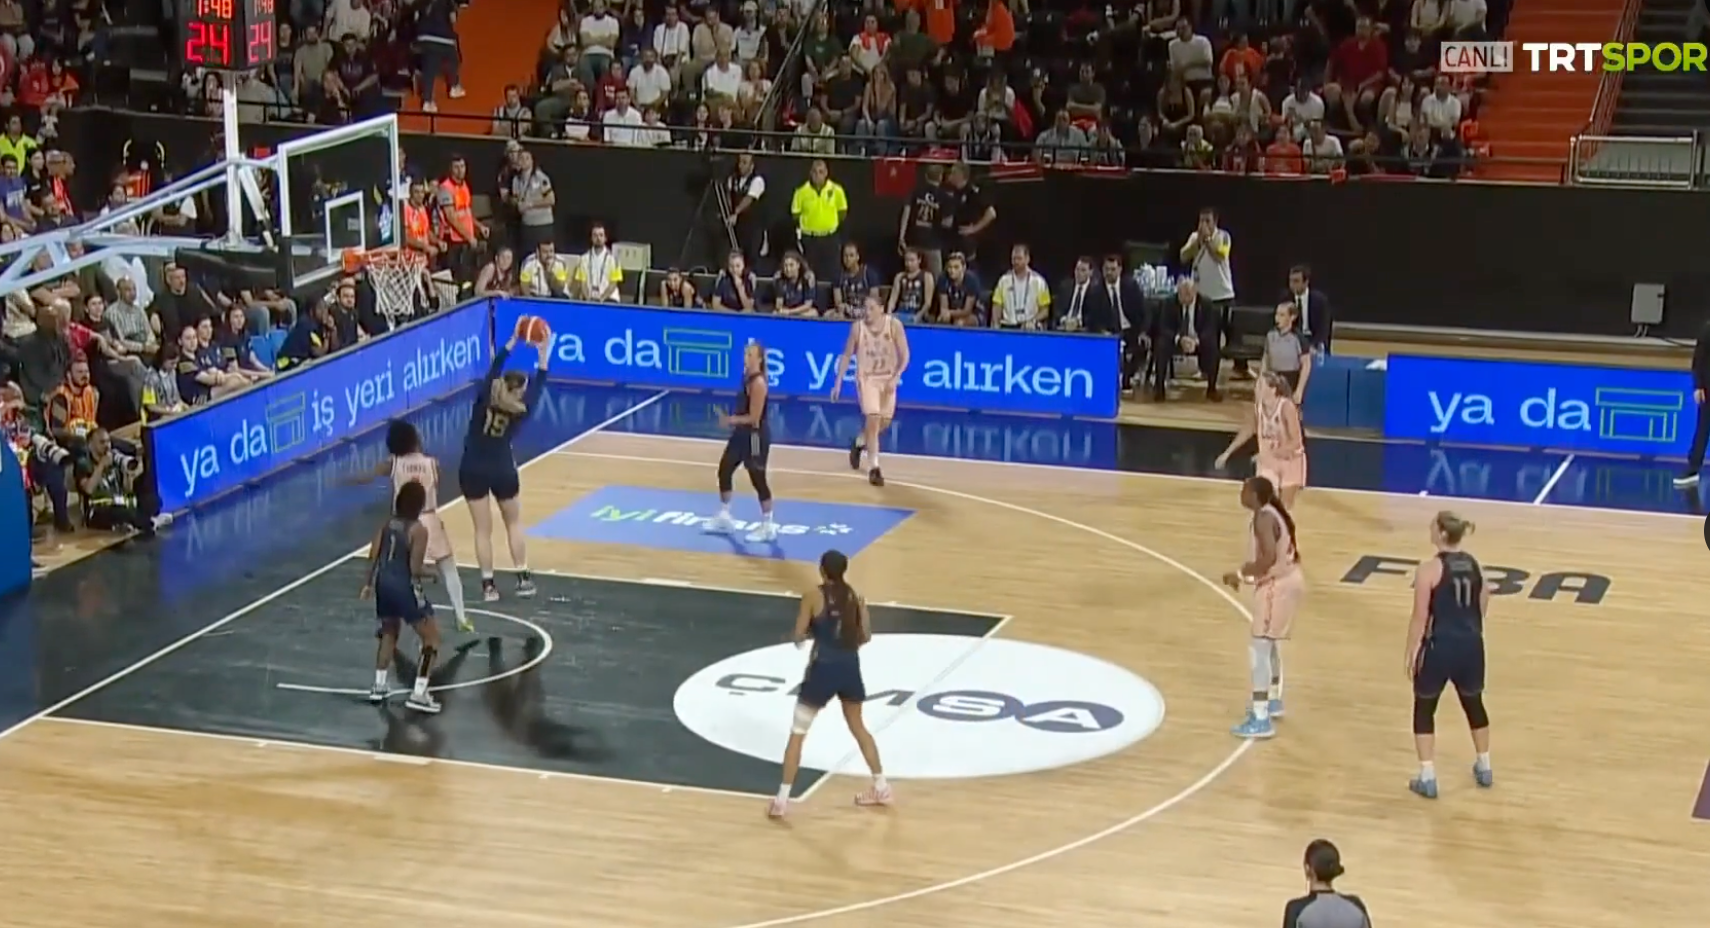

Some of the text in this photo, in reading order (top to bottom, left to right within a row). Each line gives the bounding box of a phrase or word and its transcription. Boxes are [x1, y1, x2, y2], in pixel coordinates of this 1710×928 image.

[186, 22, 229, 66] 24
[248, 21, 272, 63] 24
[604, 329, 662, 368] da
[923, 351, 1094, 399] alırken
[180, 333, 481, 498] ya da iş yeri alırken
[1428, 387, 1591, 433] ya da
[1340, 555, 1611, 605] FBA
[1453, 577, 1471, 607] 11
